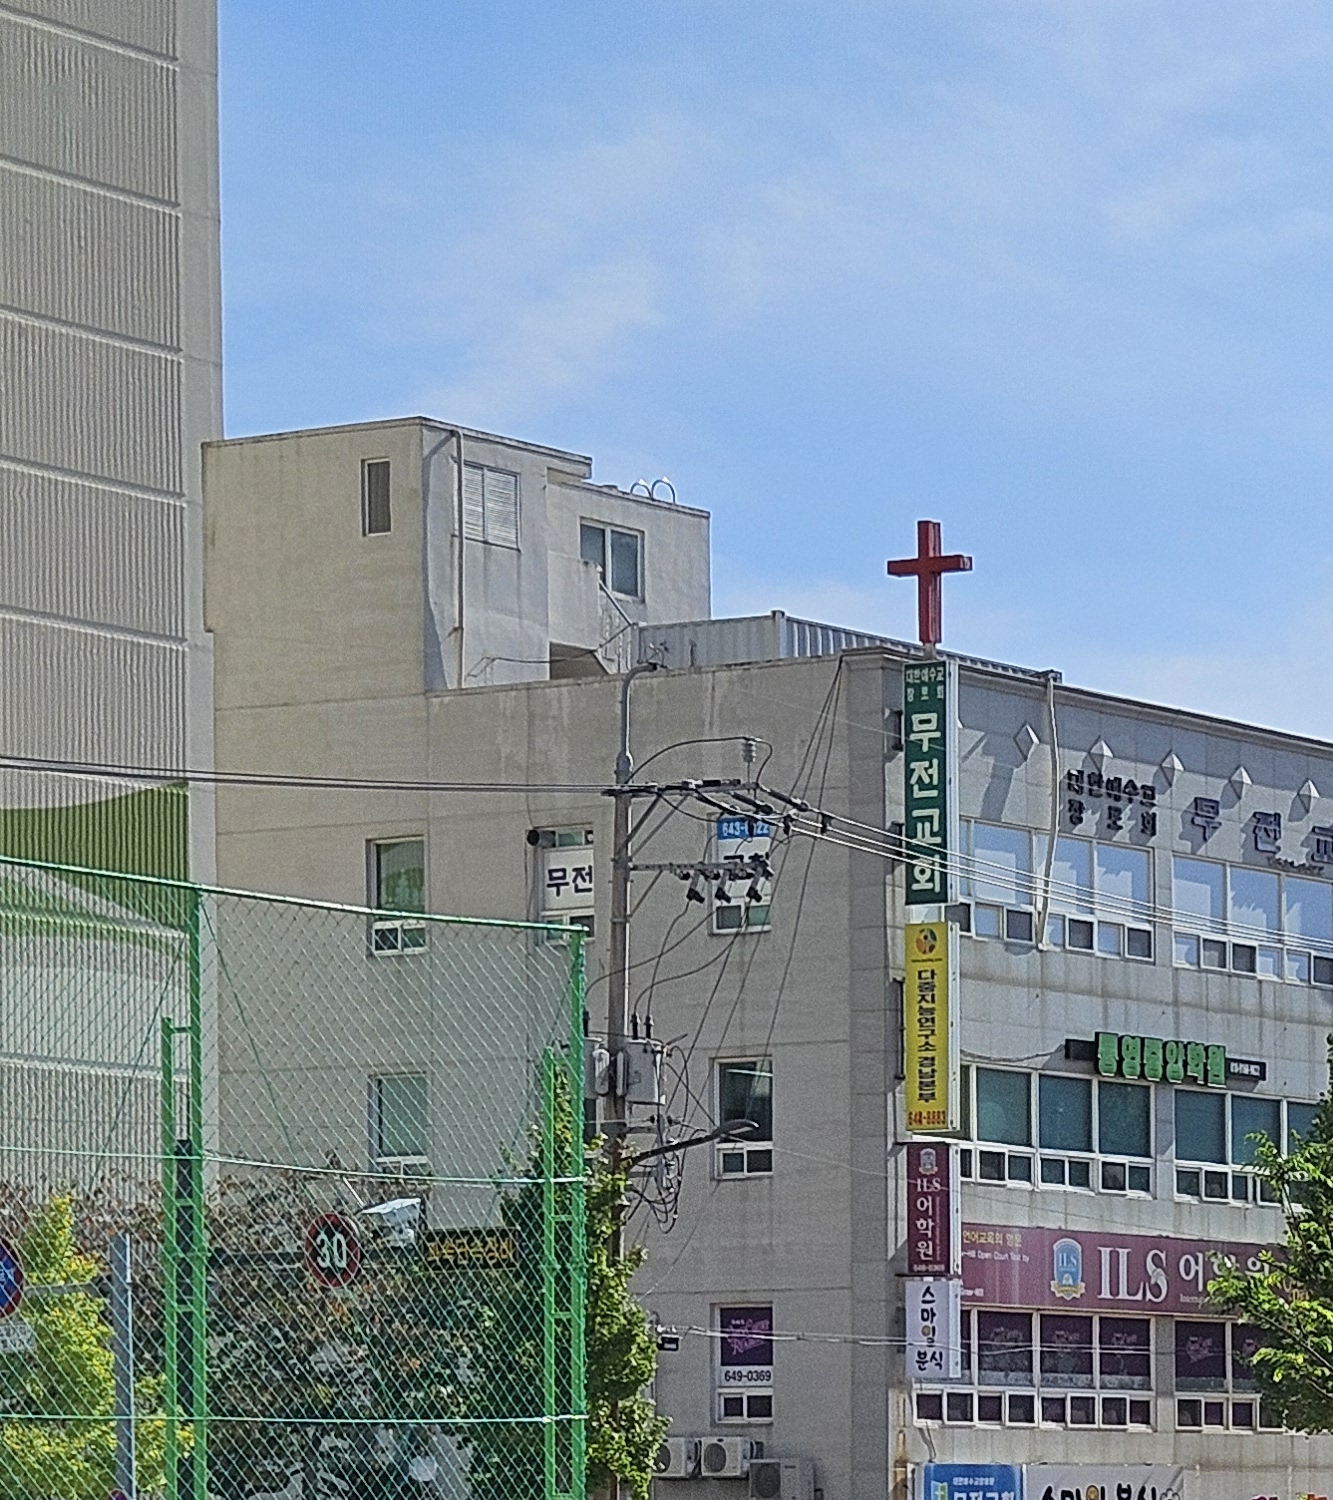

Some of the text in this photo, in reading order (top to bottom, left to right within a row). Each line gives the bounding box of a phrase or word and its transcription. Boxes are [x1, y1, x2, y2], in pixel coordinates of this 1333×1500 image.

[909, 712, 942, 893] 무전교회
[916, 1178, 941, 1193] ILS
[316, 1232, 347, 1268] 30
[916, 1196, 934, 1261] 어학원
[1058, 1253, 1078, 1268] ILS
[1097, 1246, 1168, 1303] ILS
[921, 1285, 936, 1348] 스마일
[915, 1350, 943, 1371] 분식
